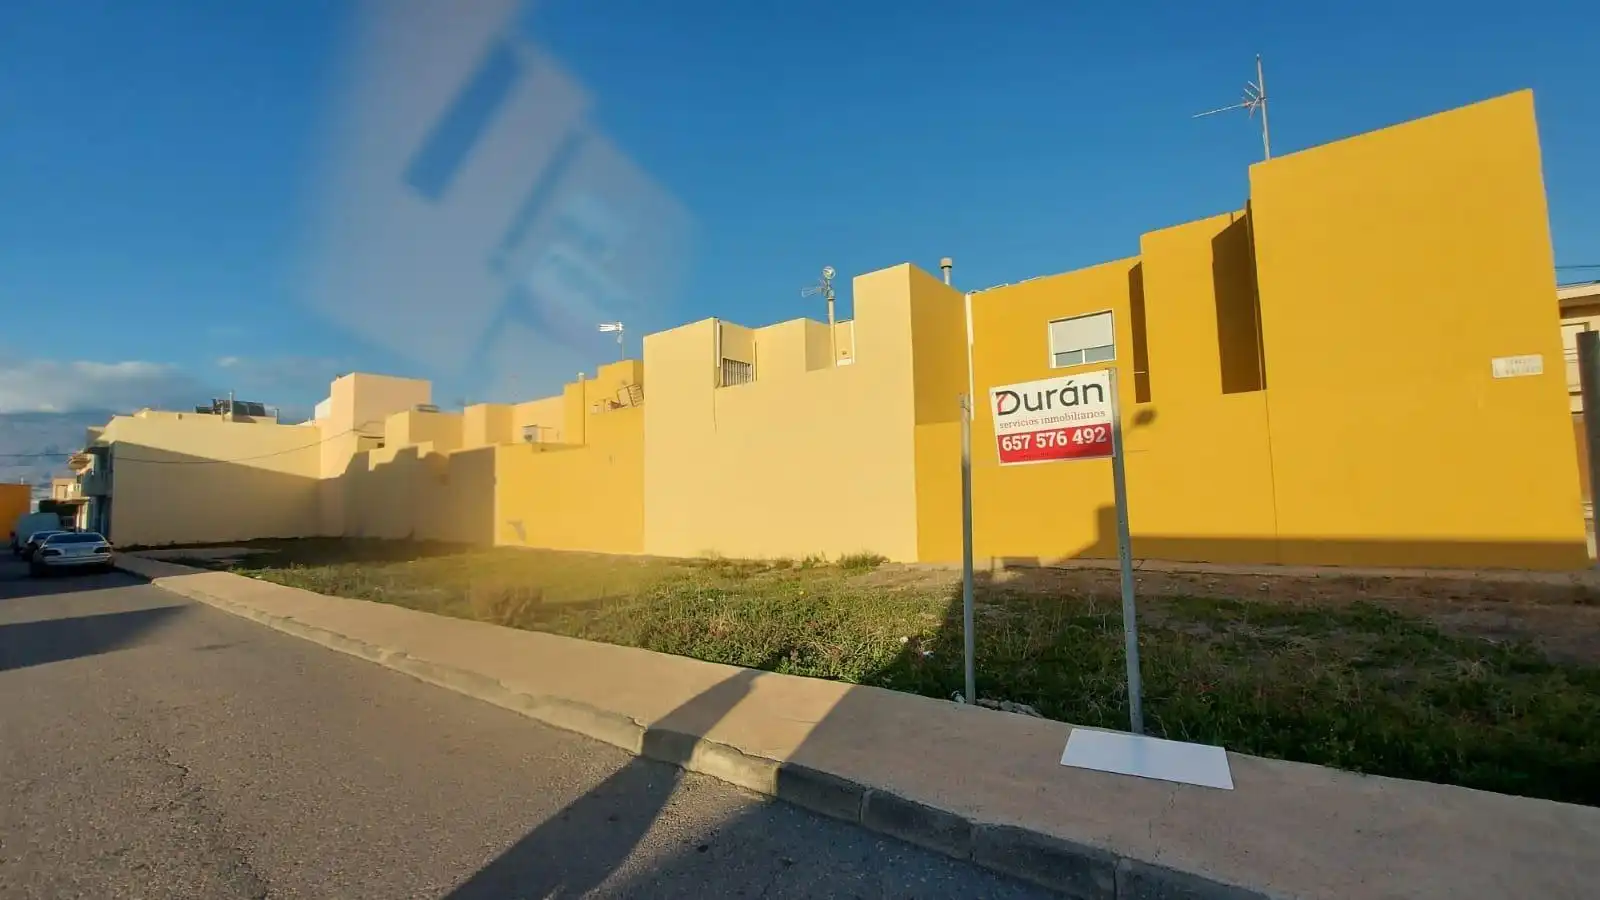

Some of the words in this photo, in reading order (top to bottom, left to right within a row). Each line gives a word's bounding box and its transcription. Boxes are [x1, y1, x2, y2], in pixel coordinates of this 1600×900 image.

[996, 380, 1103, 416] Durán
[1000, 418, 1041, 429] servicios
[1041, 410, 1105, 425] inmobiliarios
[1002, 434, 1032, 451] 657
[1036, 430, 1067, 448] 576
[1072, 427, 1107, 445] 492
